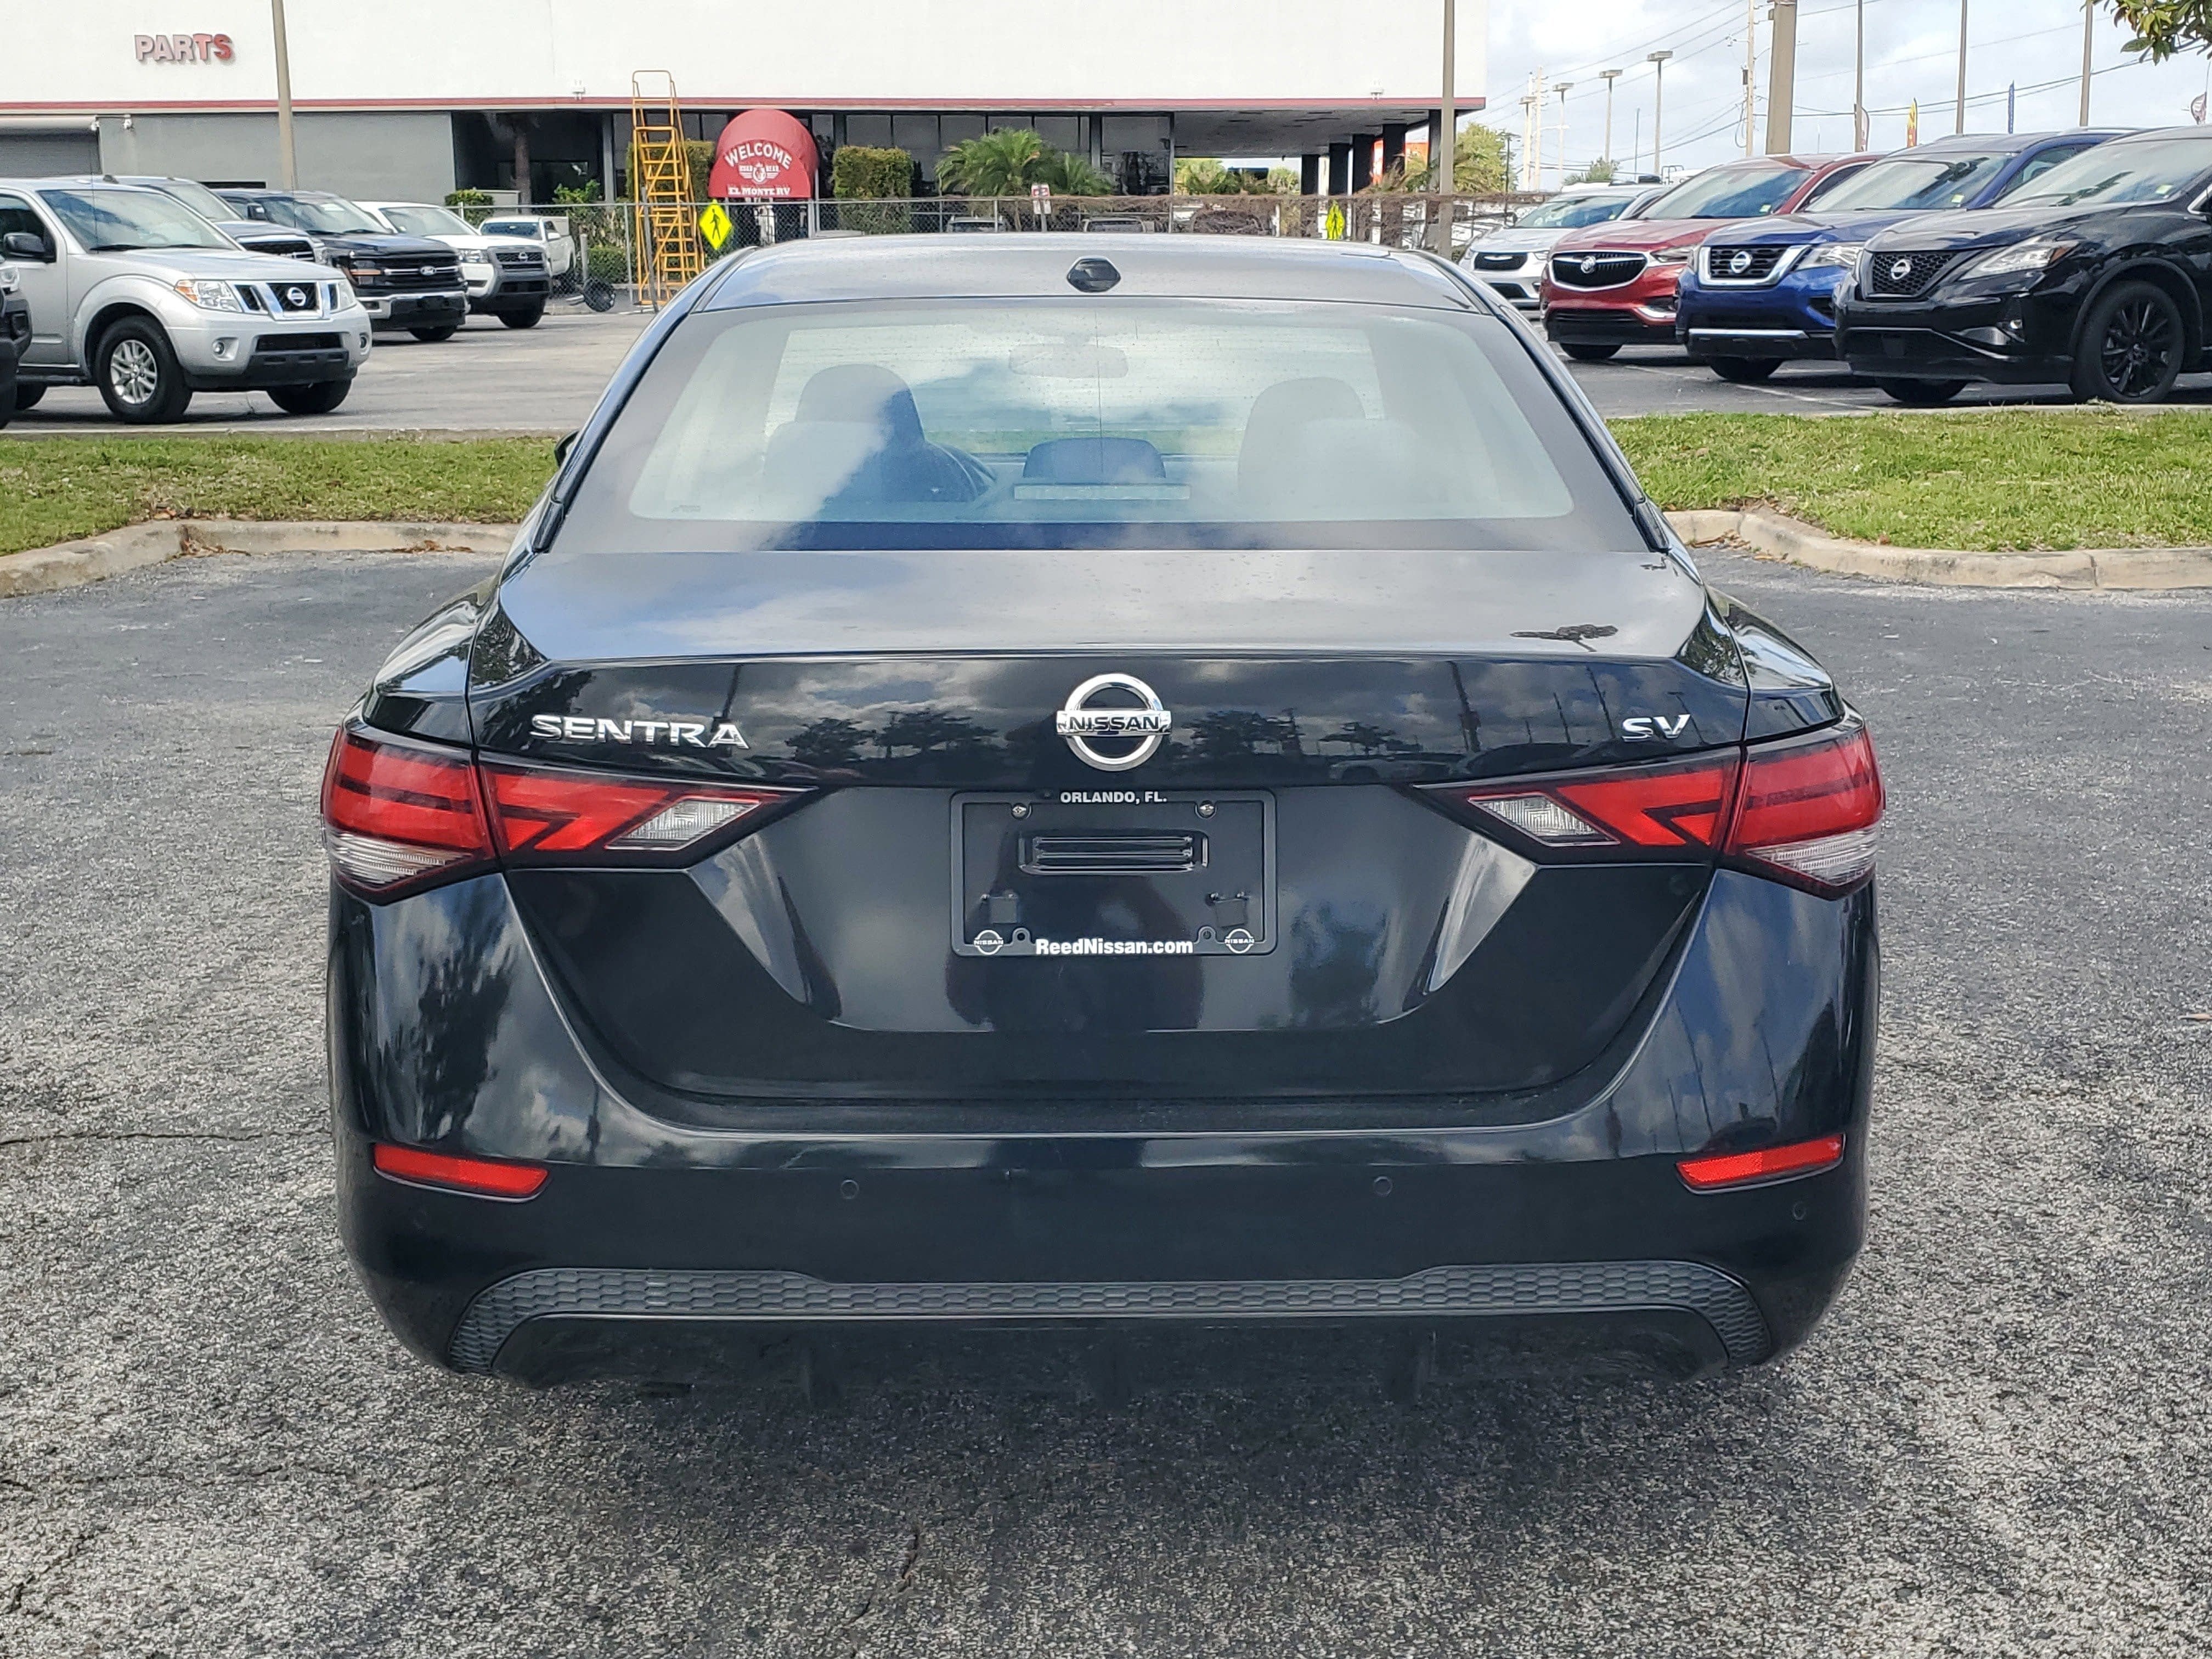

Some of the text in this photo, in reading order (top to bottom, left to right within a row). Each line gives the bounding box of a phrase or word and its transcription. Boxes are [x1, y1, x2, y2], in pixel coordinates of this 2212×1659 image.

[134, 33, 233, 61] PARTS
[724, 142, 793, 170] WELCOME
[728, 187, 791, 196] EL MONTE RV
[530, 714, 750, 749] SENTRA
[1069, 715, 1160, 731] NISSAN
[1622, 714, 1691, 742] SV
[1060, 791, 1167, 805] ORLANDO, FL.
[1035, 938, 1194, 955] ReedNissan.com
